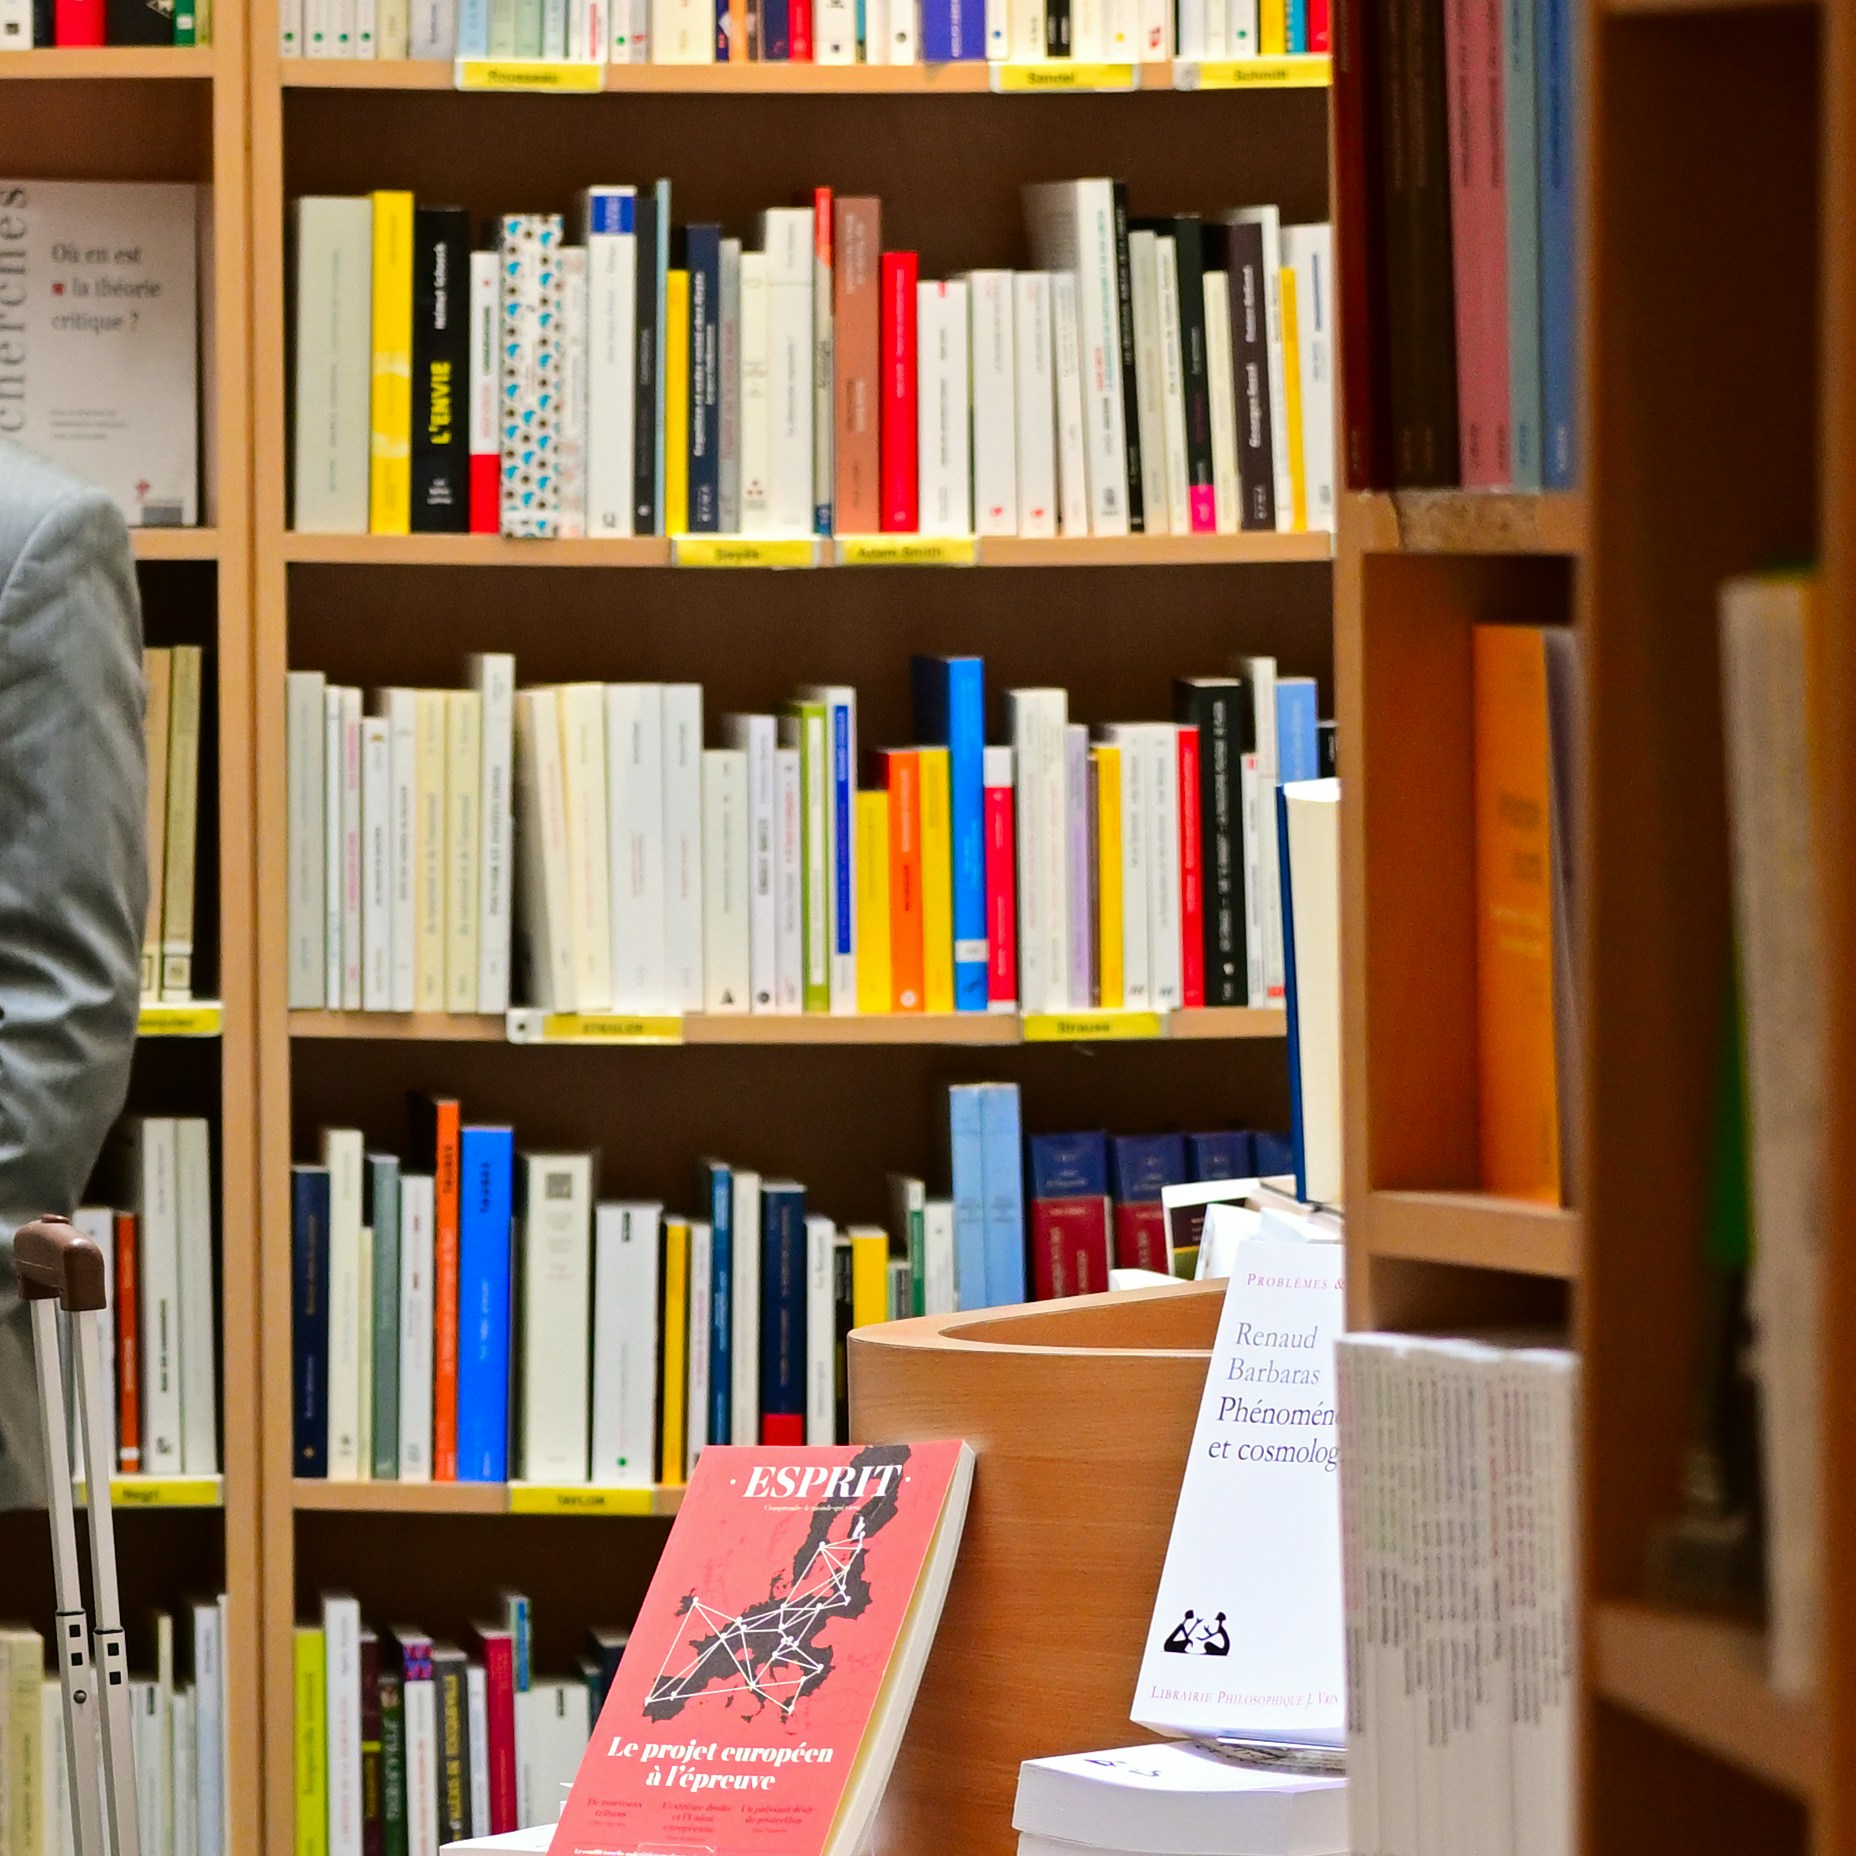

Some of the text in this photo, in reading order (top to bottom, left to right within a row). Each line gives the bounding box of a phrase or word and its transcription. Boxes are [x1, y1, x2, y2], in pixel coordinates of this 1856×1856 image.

[429, 360, 452, 445] L'ENVIE
[856, 544, 942, 561] Adam Smith
[1246, 1272, 1328, 1290] PROBLÈMES
[1235, 1321, 1319, 1349] Renaud
[1227, 1357, 1321, 1386] Barbaras
[1216, 1395, 1337, 1427] Phénomén
[1208, 1437, 1340, 1473] et cosmolog
[742, 1464, 903, 1499] ESPRIT
[1150, 1685, 1213, 1703] LIBRAIRIE
[1216, 1690, 1304, 1709] PHILOSOPHIQUE
[606, 1736, 835, 1768] Le projet européen
[645, 1766, 777, 1793] à l'épreuve
